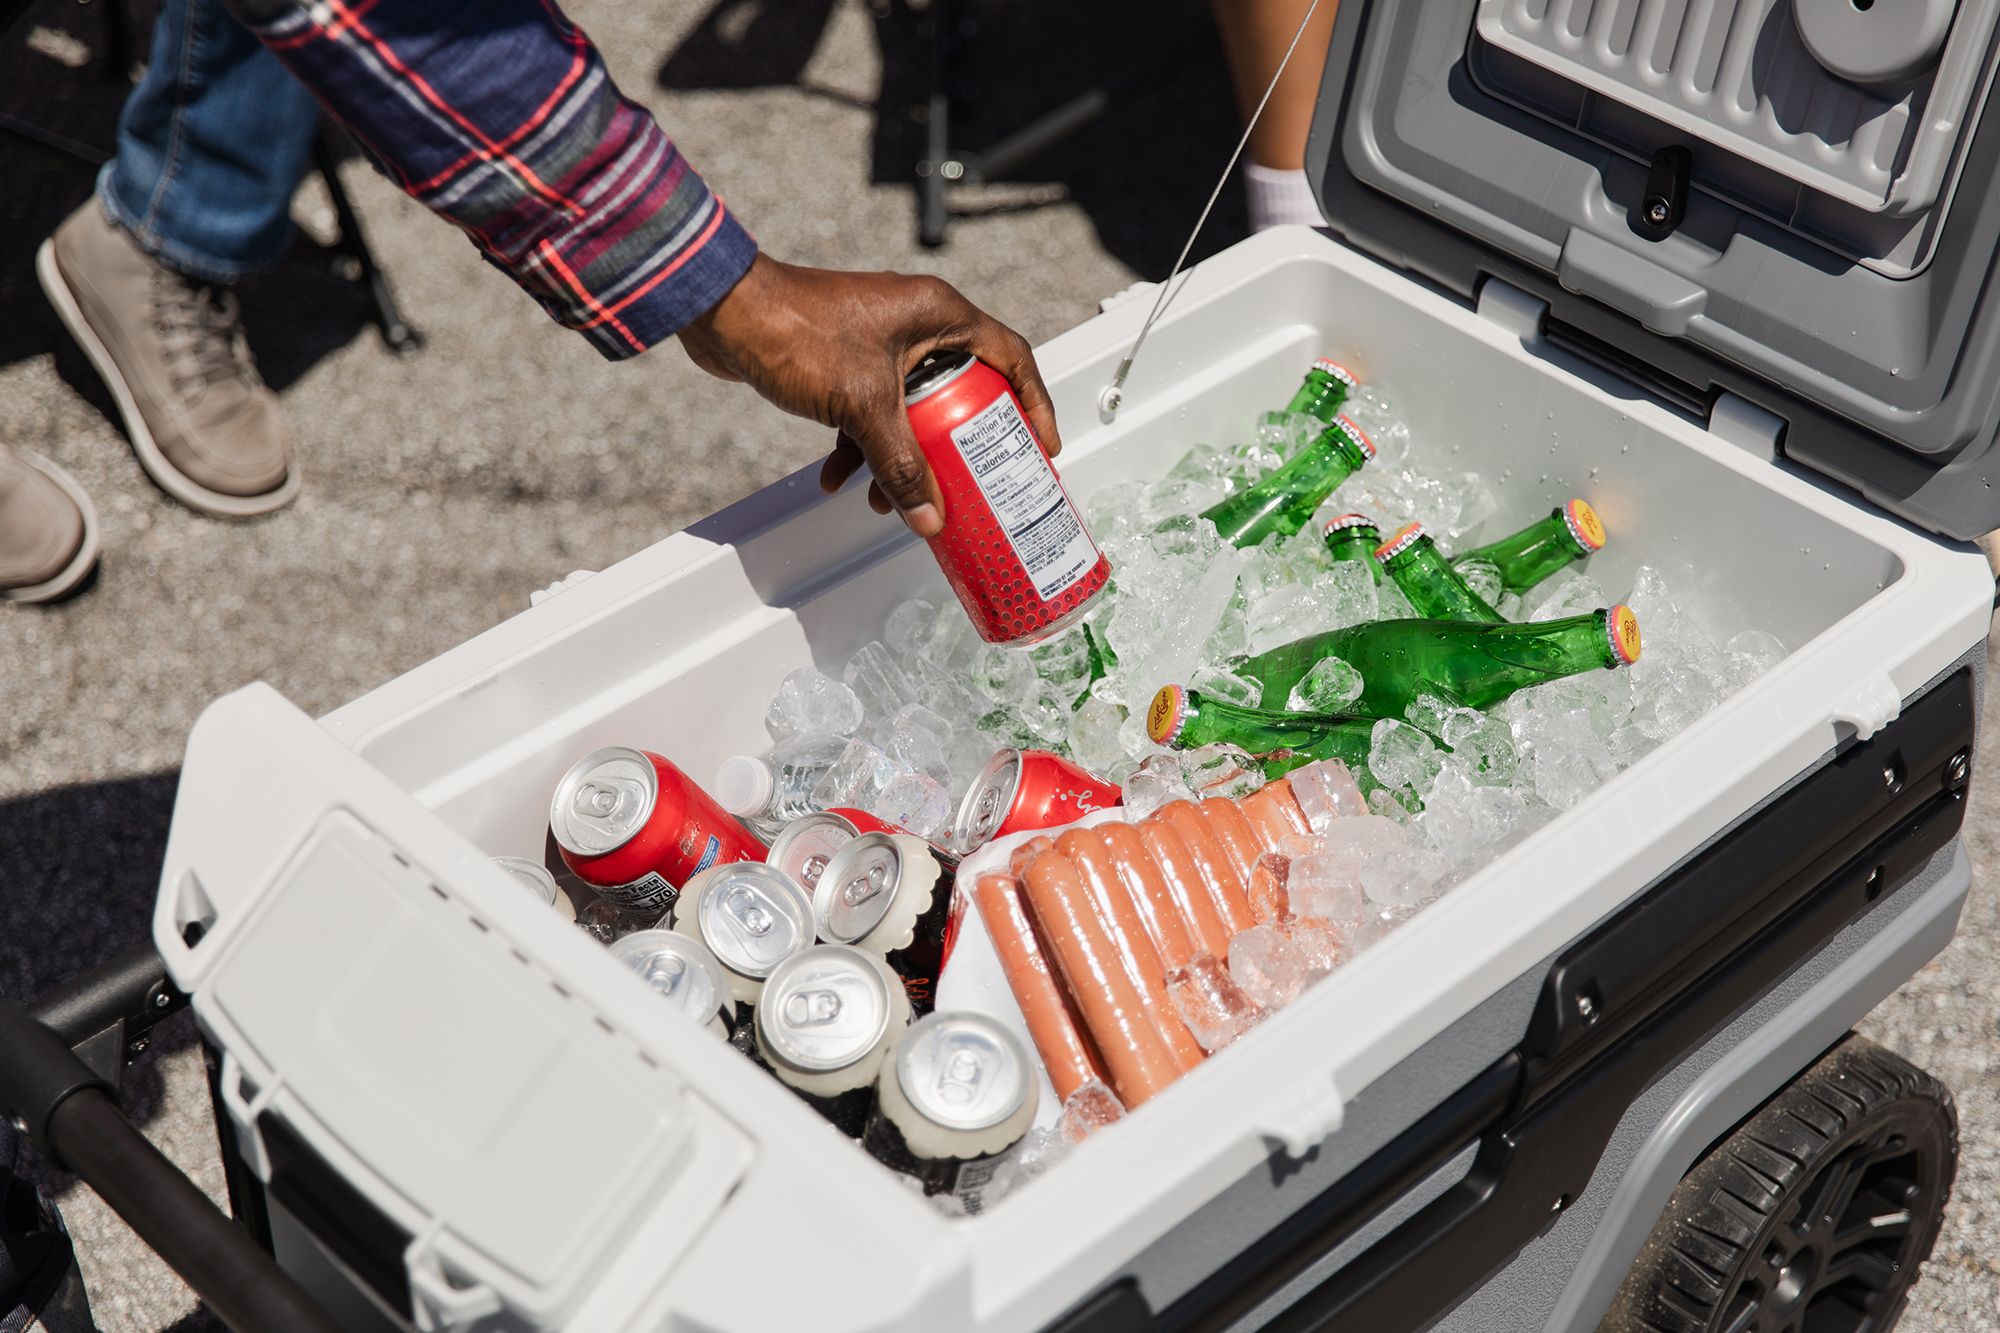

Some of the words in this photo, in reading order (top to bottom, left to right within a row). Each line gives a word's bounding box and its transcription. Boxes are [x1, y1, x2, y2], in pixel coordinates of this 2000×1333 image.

[959, 417, 998, 448] Nutrition
[997, 404, 1014, 422] Facts
[974, 446, 1010, 475] Calories
[1013, 426, 1029, 446] 170
[631, 879, 659, 893] Facts
[649, 889, 673, 902] 170
